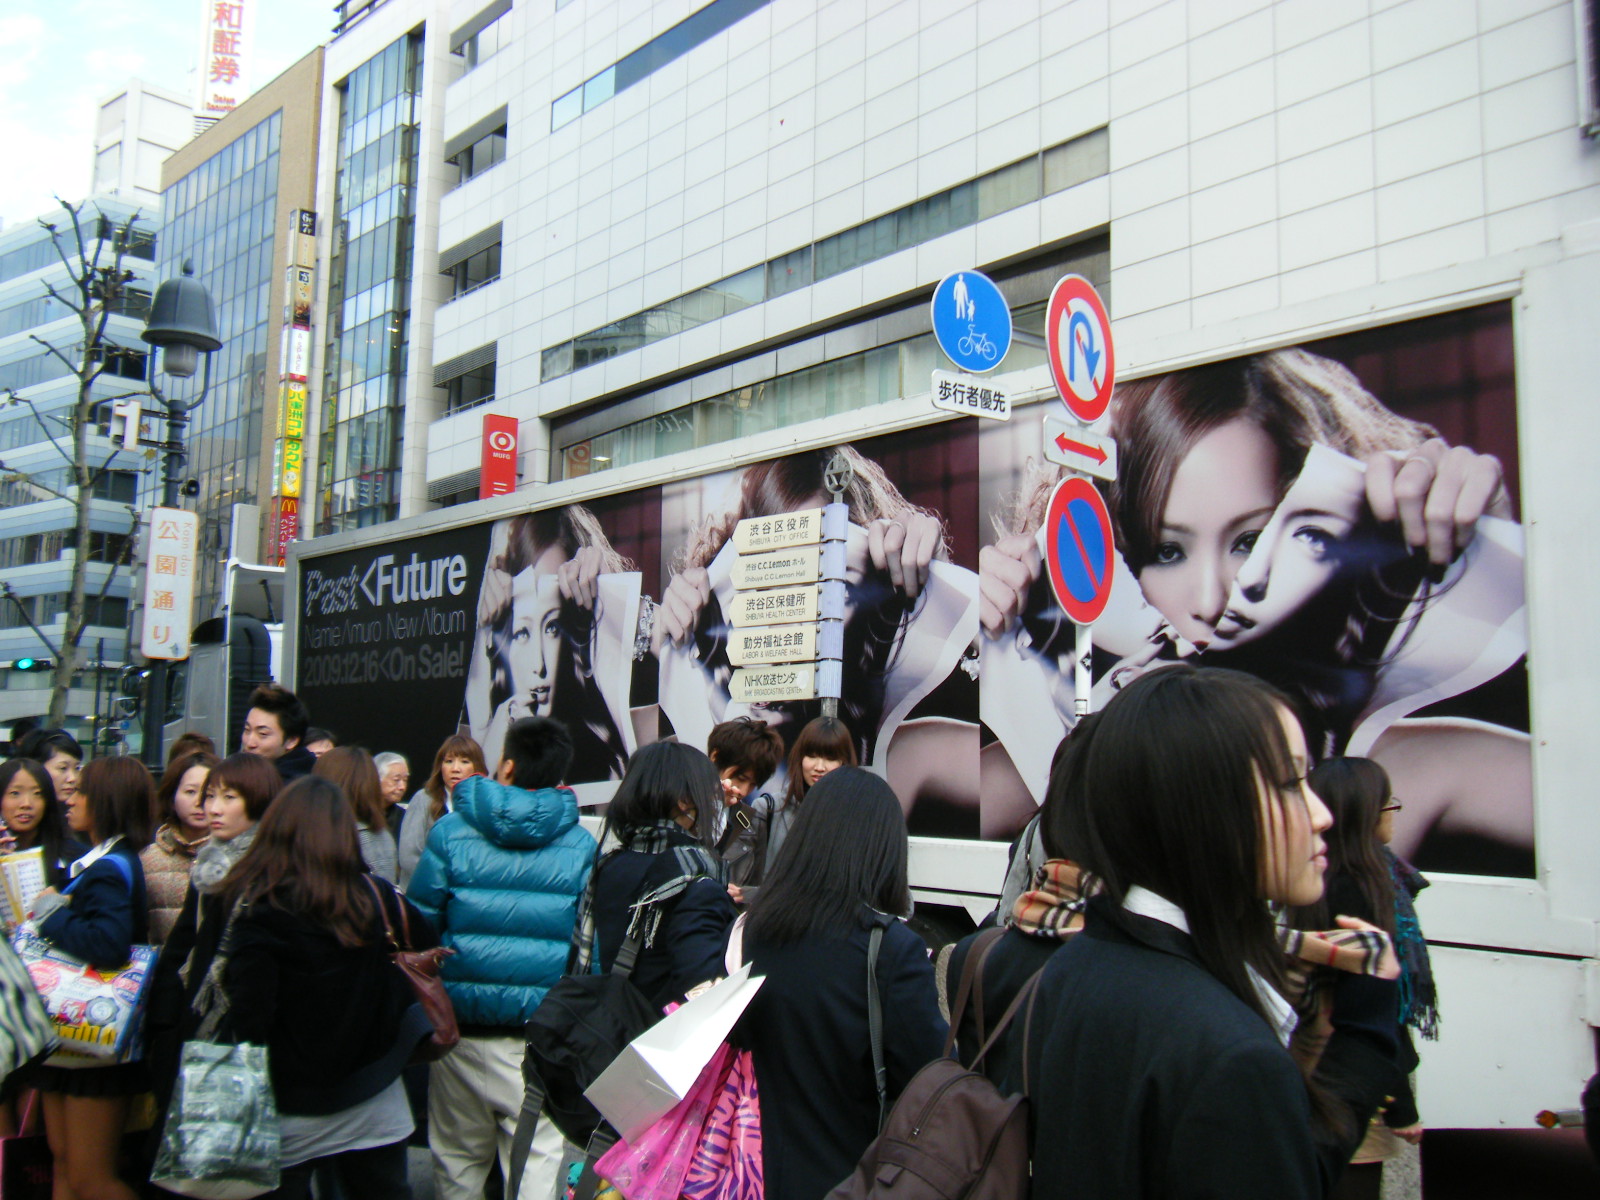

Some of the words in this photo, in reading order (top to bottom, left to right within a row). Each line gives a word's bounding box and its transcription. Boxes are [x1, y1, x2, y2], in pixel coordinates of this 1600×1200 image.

[209, 0, 244, 84] 和証券
[939, 380, 1006, 413] 歩行者優先
[492, 452, 511, 460] MUFG
[750, 516, 809, 537] 渋谷区役所
[773, 535, 786, 543] CITY
[789, 531, 809, 540] OFFICE
[152, 520, 180, 645] 公園通り
[746, 593, 806, 611] 渋谷区保健所
[745, 613, 764, 621] SHIBUYA
[765, 610, 785, 618] HEALTH
[786, 608, 806, 617] CENTER
[305, 622, 342, 649] Namie
[387, 612, 418, 640] New
[420, 607, 466, 636] Album
[743, 632, 804, 650] 勤労福祉会館
[418, 640, 465, 680] Sale!
[742, 651, 759, 659] LABOR
[765, 649, 788, 657] WELFARE
[789, 648, 803, 656] HALL
